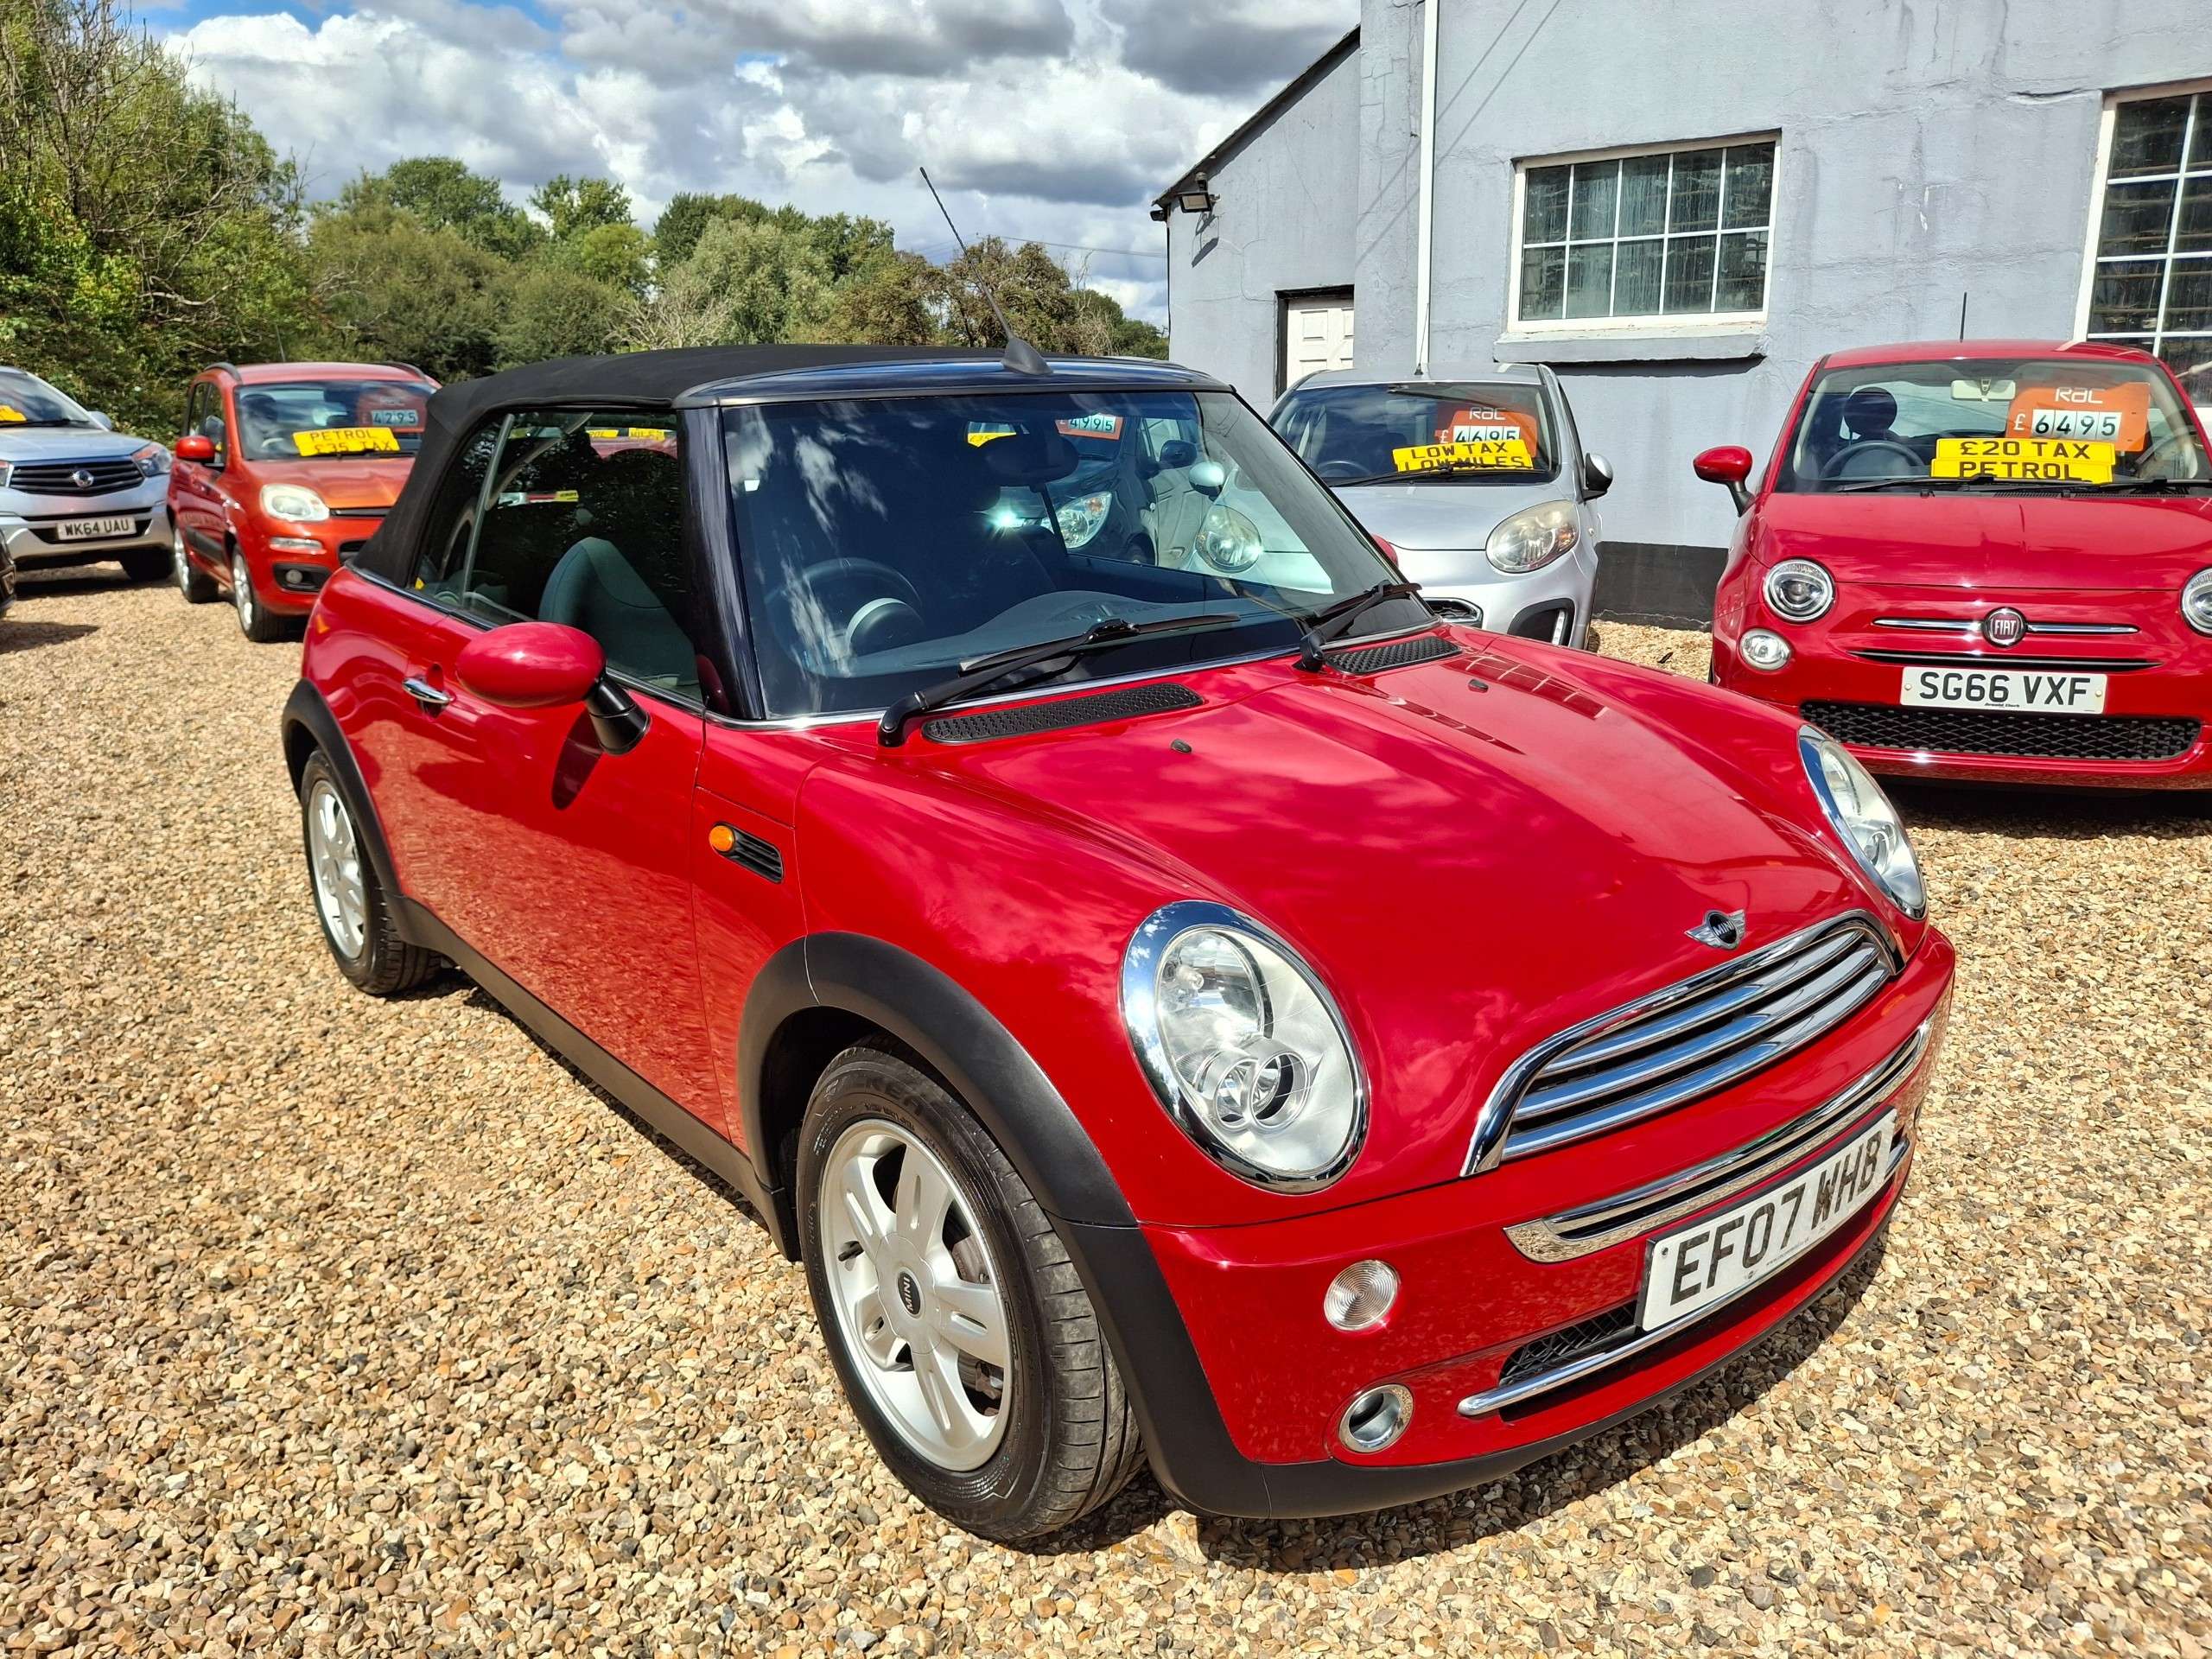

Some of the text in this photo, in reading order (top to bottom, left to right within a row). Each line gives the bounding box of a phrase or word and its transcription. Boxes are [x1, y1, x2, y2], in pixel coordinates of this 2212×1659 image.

[310, 429, 377, 442] PETROL
[359, 439, 392, 451] TAX
[1411, 442, 1508, 459] LOW TAX
[1960, 441, 2090, 460] £20 TAX
[1959, 461, 2082, 480] PETROL
[65, 519, 130, 536] WK64 UAU
[1994, 620, 2017, 636] FIAT
[1919, 671, 2091, 706] SG66 VXF
[1713, 920, 1735, 937] MINI
[1670, 1130, 1882, 1306] EF07 WHB
[903, 1276, 914, 1312] MINI
